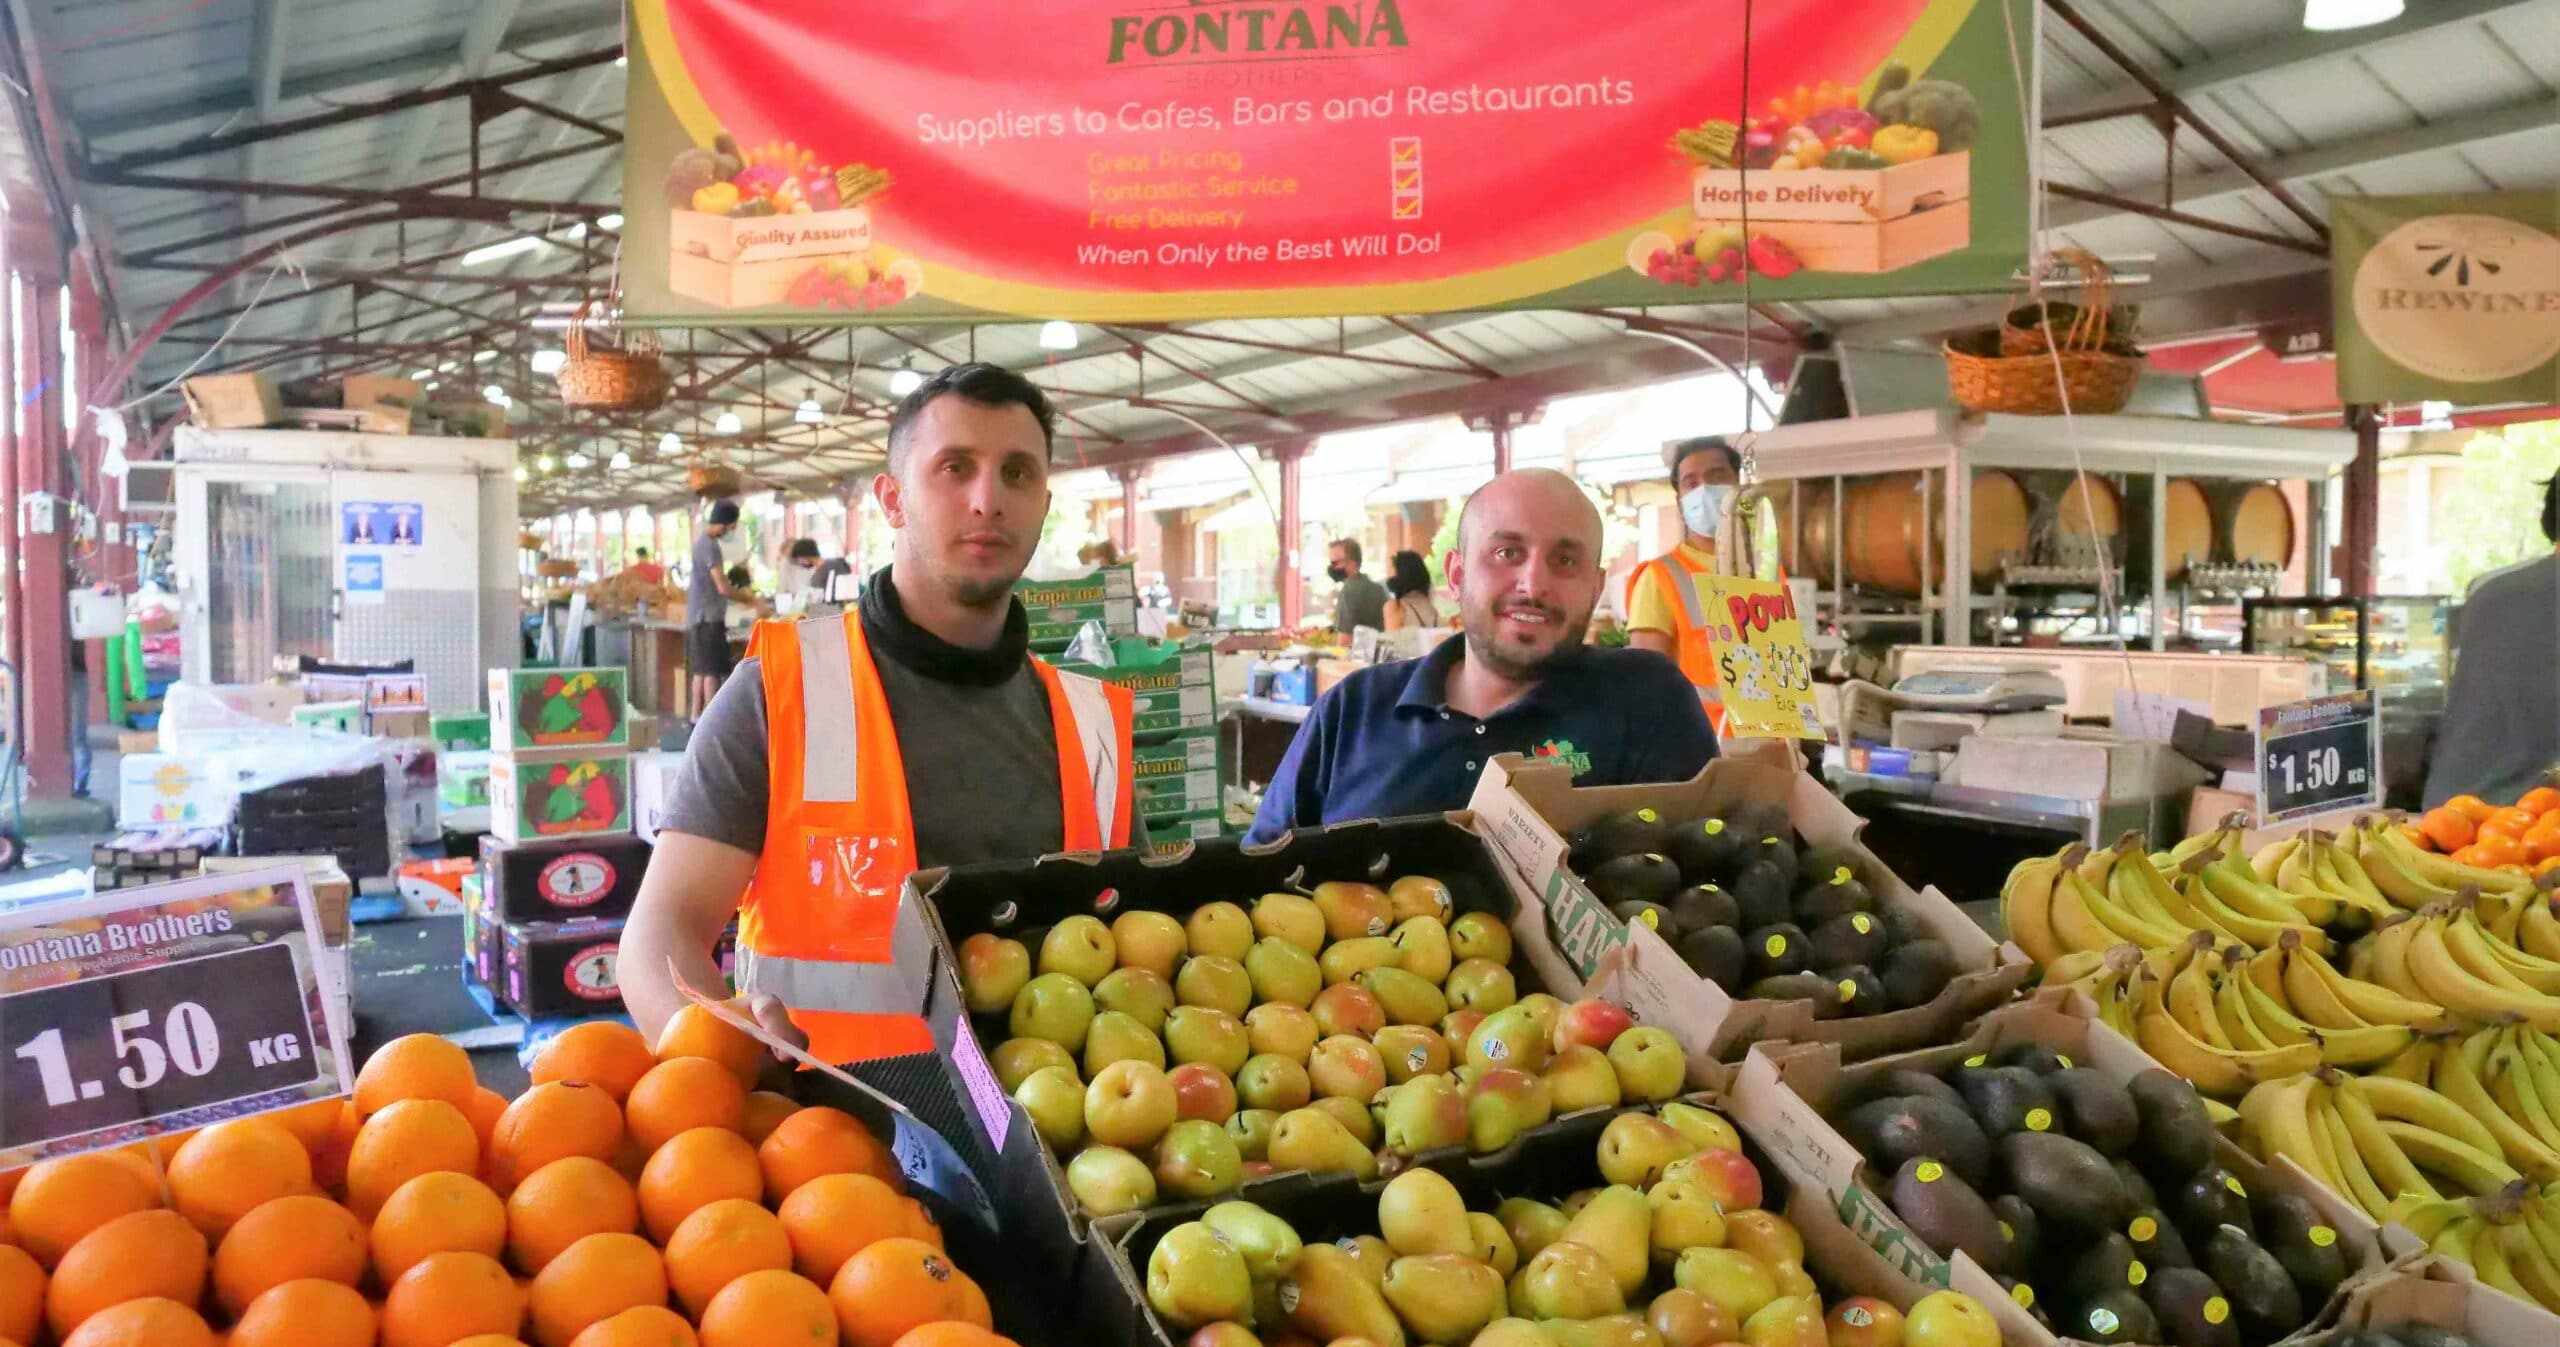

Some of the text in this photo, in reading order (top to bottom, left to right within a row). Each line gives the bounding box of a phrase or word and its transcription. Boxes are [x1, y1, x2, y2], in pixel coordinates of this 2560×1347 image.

[1106, 0, 1409, 64] FONTANA
[917, 75, 1634, 148] Suppliers to Cafes, Bars and Restaurants
[1088, 149, 1242, 174] Great Pricing
[1088, 176, 1297, 203] Fantastic Service
[1701, 185, 1874, 208] Home Delivery
[1088, 208, 1245, 230] Free Delivery
[736, 224, 869, 248] Quality Assured
[1077, 232, 1441, 268] When Only the Best Will Do!
[2347, 768, 2365, 785] KG
[0, 908, 233, 971] ontana Brothers
[15, 1002, 301, 1107] 1.50 KG
